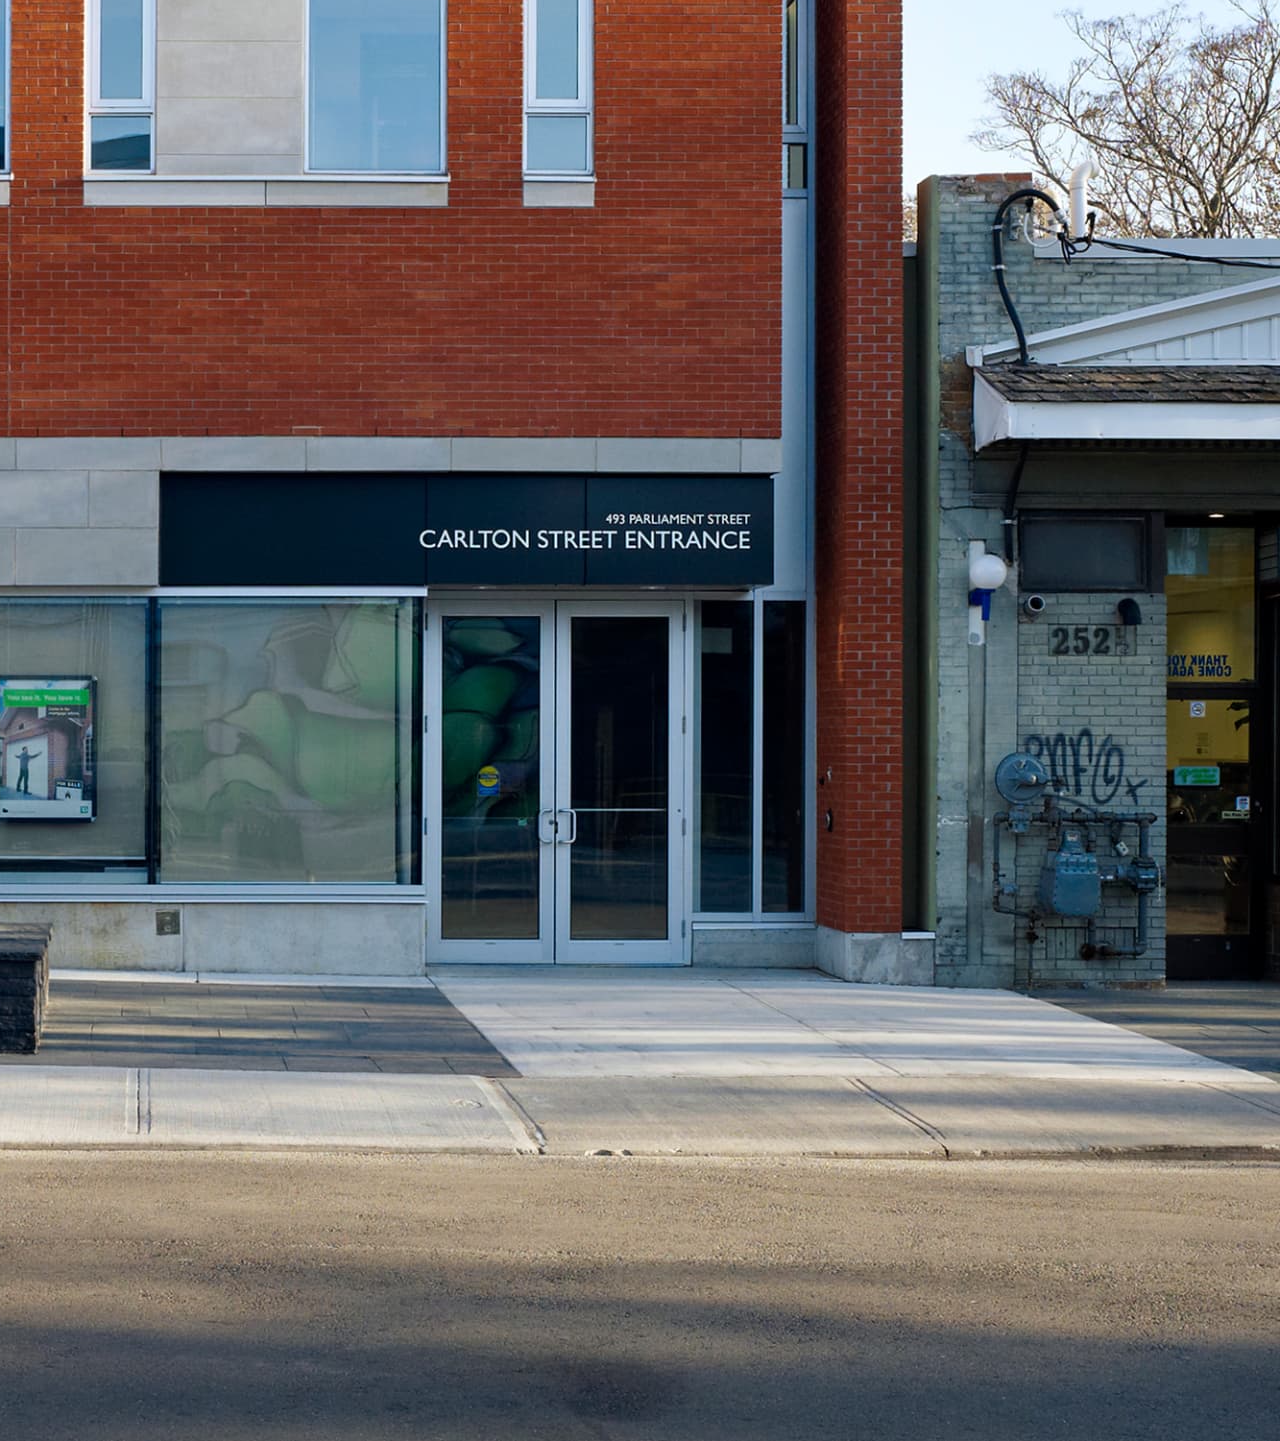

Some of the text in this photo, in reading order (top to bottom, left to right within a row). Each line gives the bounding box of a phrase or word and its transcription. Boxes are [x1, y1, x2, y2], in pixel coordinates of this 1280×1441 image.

[605, 513, 751, 526] 493 PARLIAMENT STREET
[418, 529, 751, 550] CARLTON STREET ENTRANCE
[1052, 627, 1111, 655] 252
